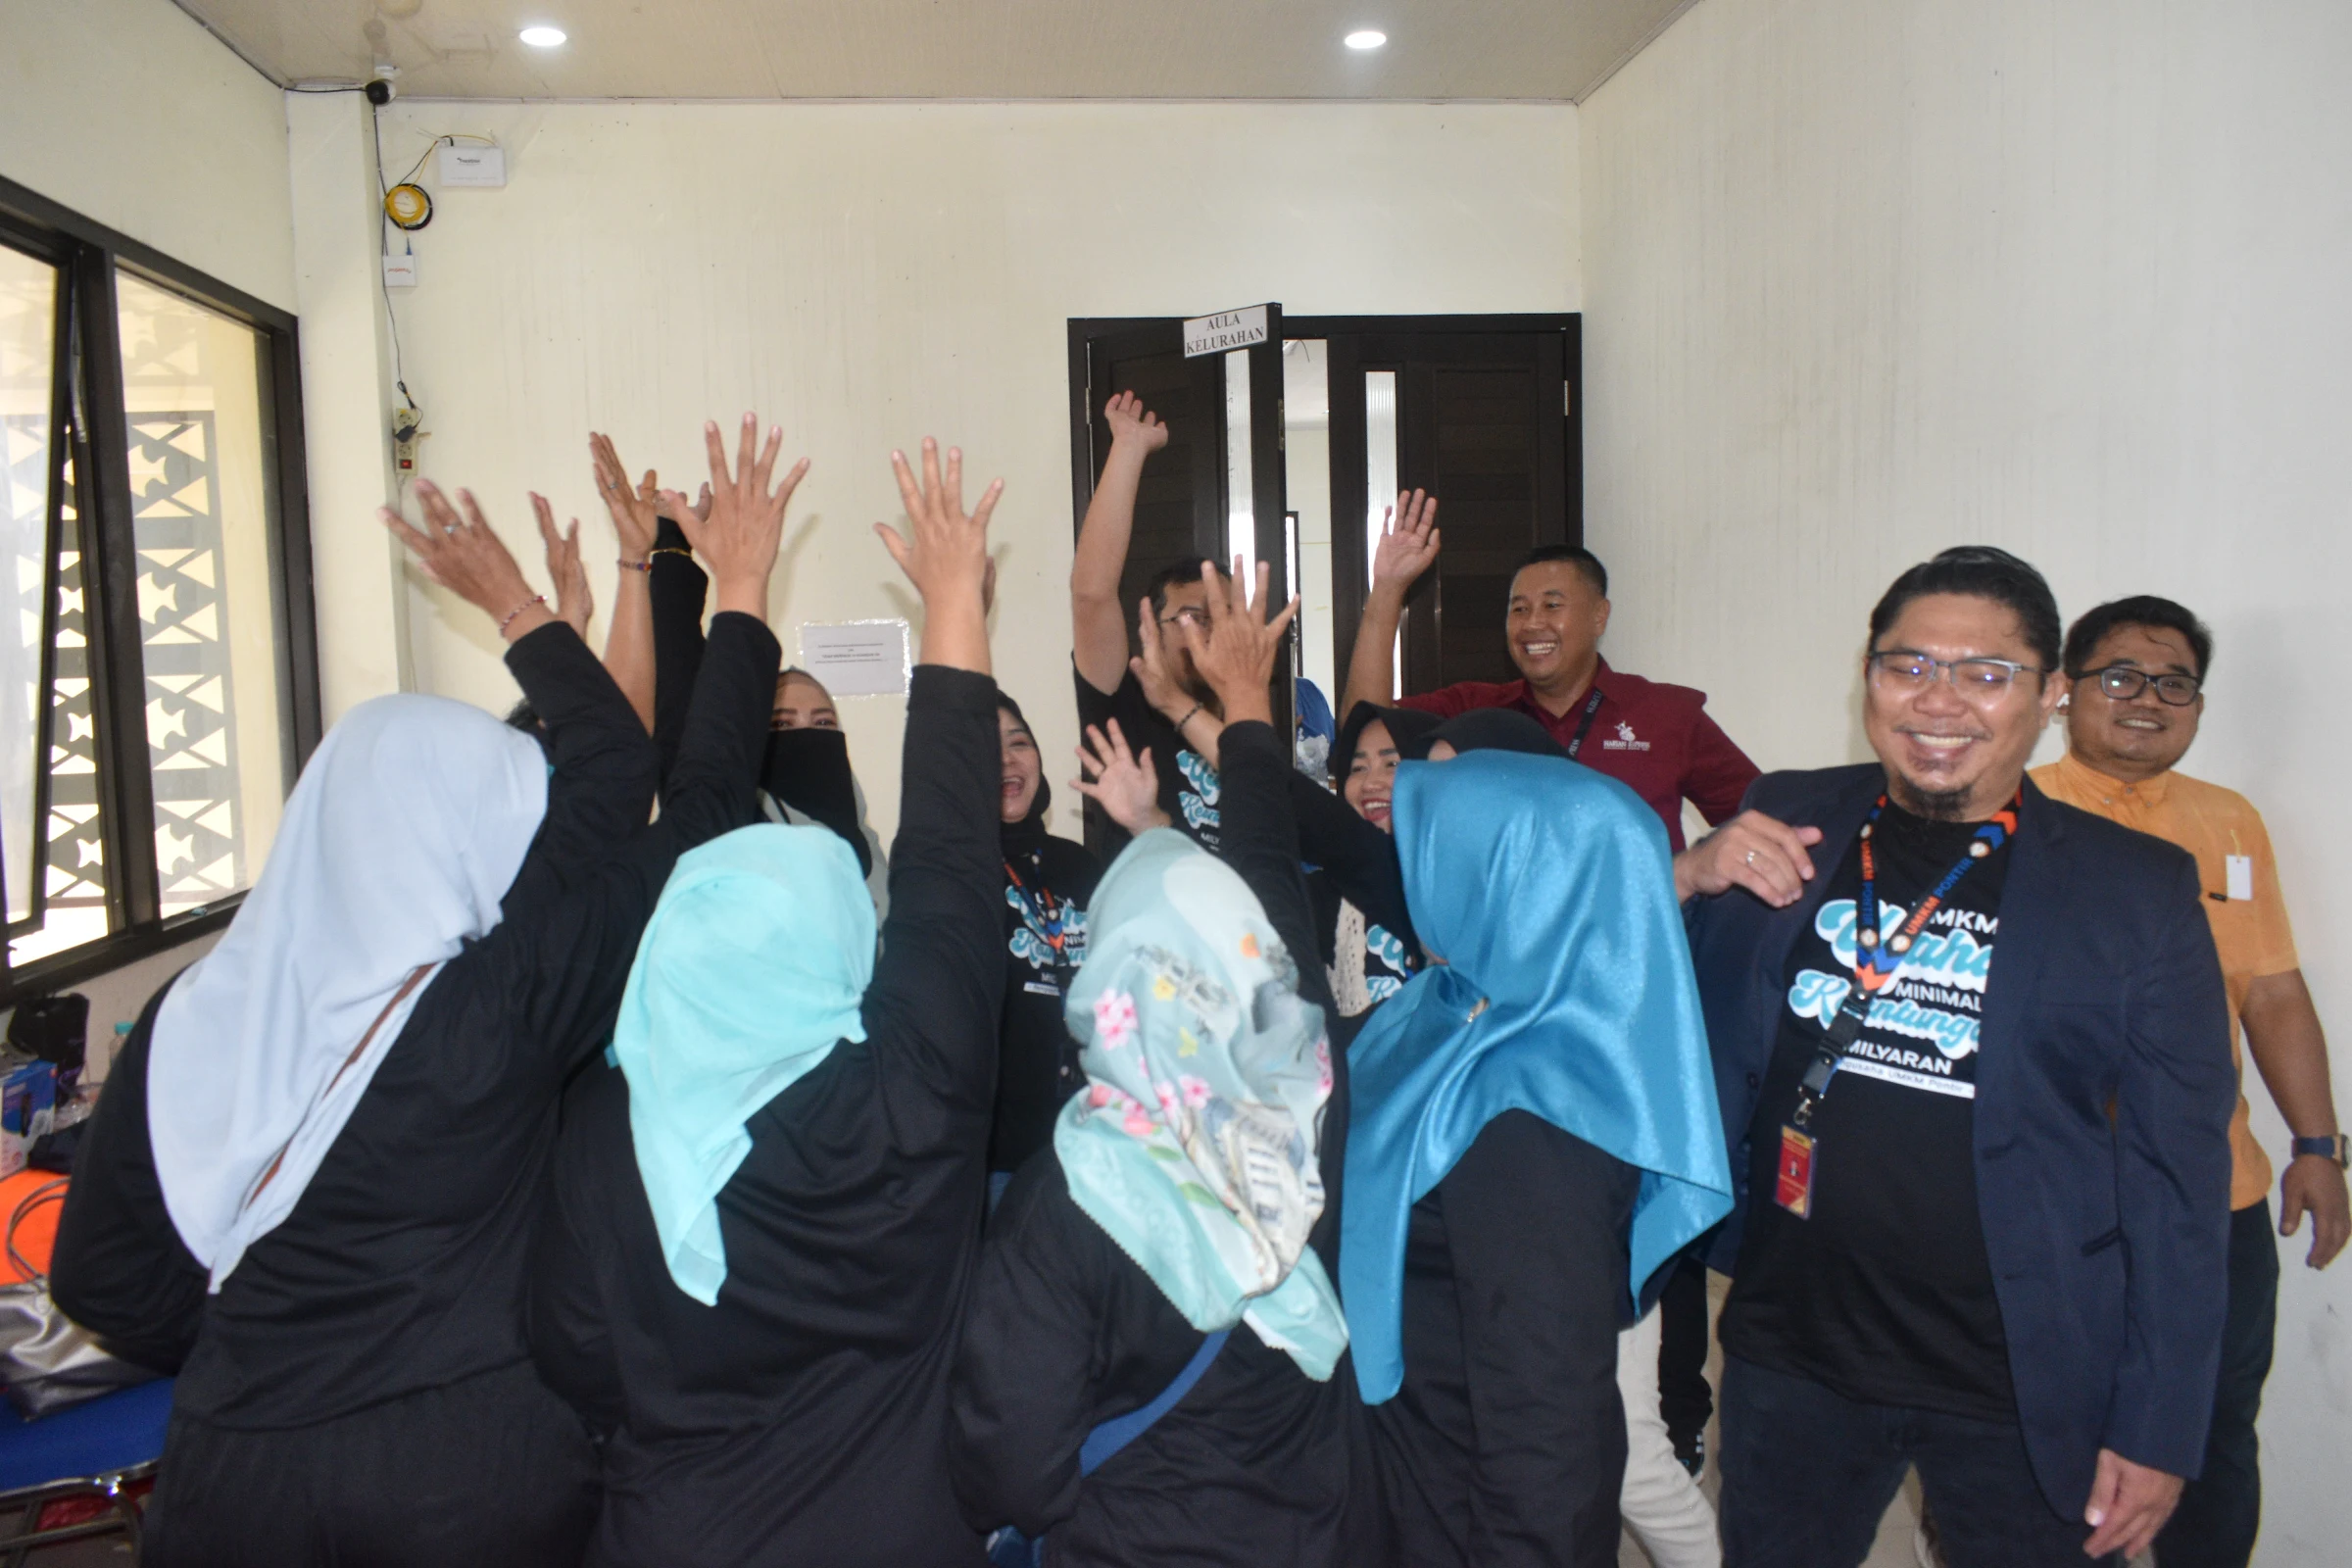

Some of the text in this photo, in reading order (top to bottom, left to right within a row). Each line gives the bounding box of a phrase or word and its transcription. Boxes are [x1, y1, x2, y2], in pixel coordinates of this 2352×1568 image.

[1206, 313, 1241, 331] AULA
[1186, 326, 1264, 354] KELURAHAN
[1905, 895, 1941, 935] UMKM
[1928, 907, 1999, 934] MKM
[1847, 1039, 1953, 1076] MILYARAN
